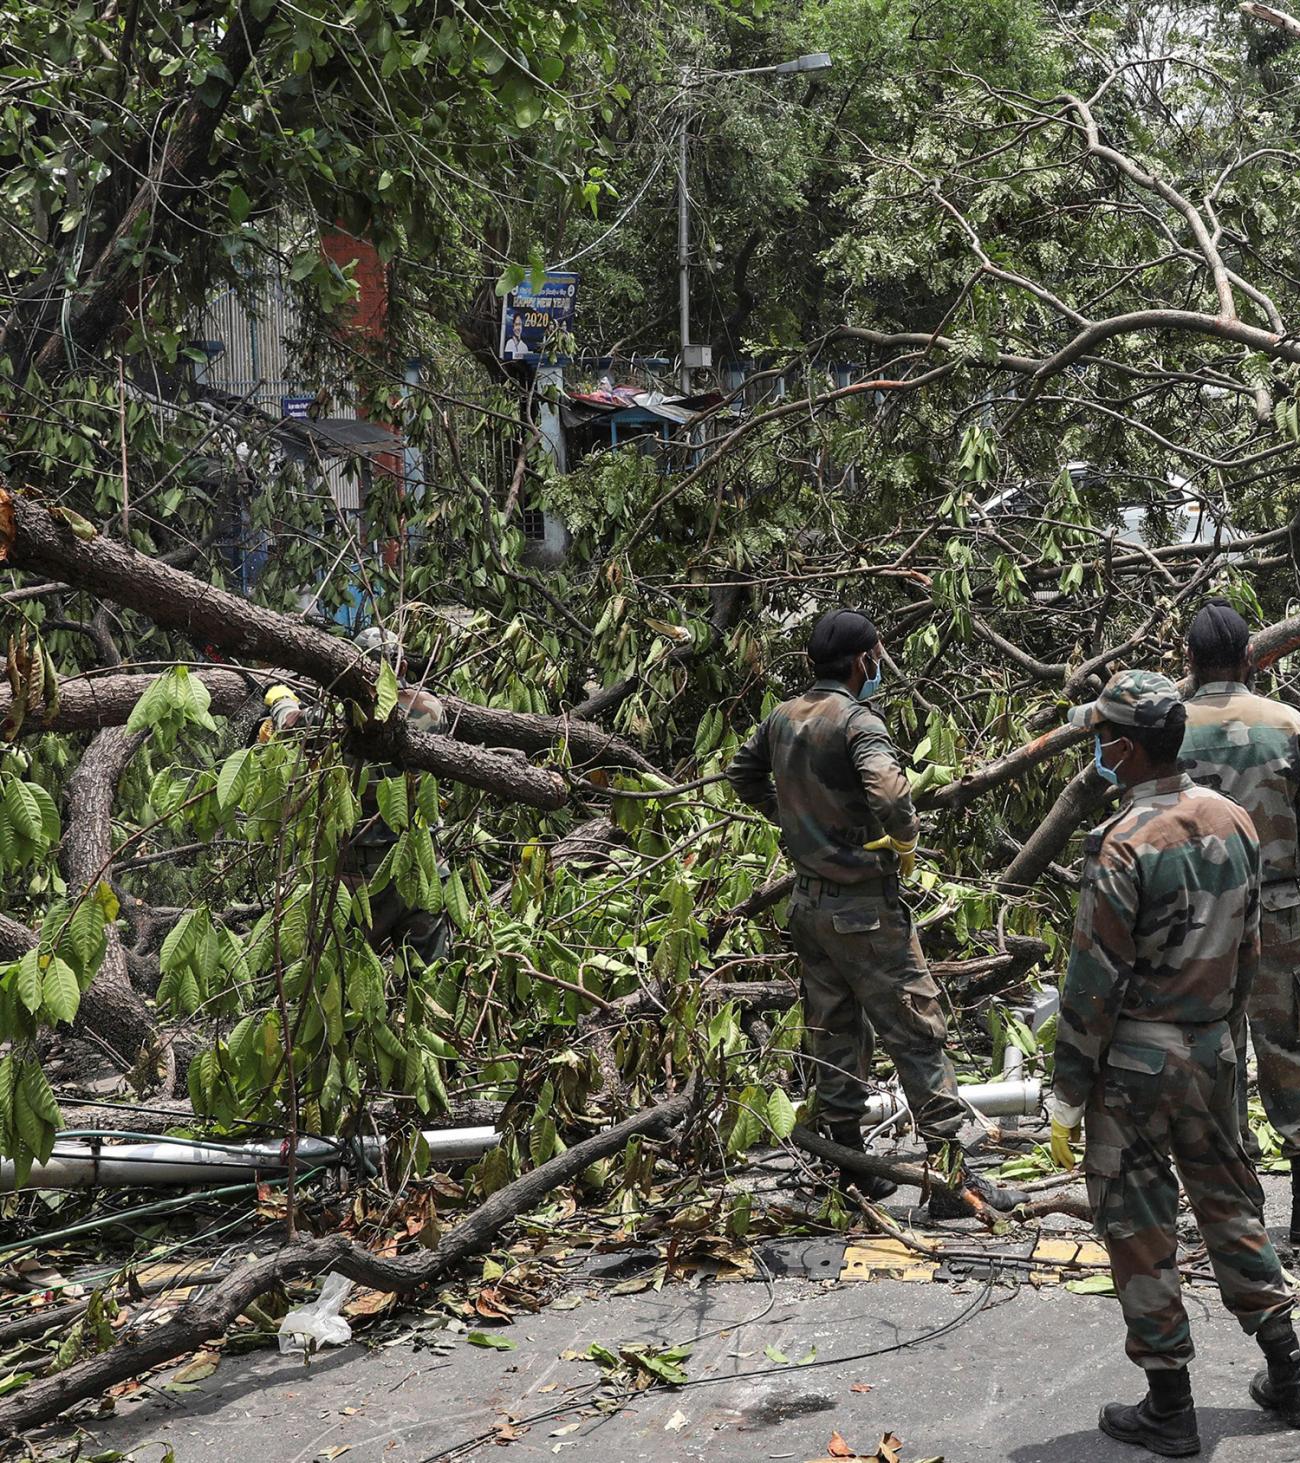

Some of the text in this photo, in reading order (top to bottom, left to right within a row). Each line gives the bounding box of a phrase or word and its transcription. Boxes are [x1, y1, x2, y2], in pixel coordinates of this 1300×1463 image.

[513, 297, 571, 307] HAPPY NEW YEAR
[524, 312, 549, 327] 2020
